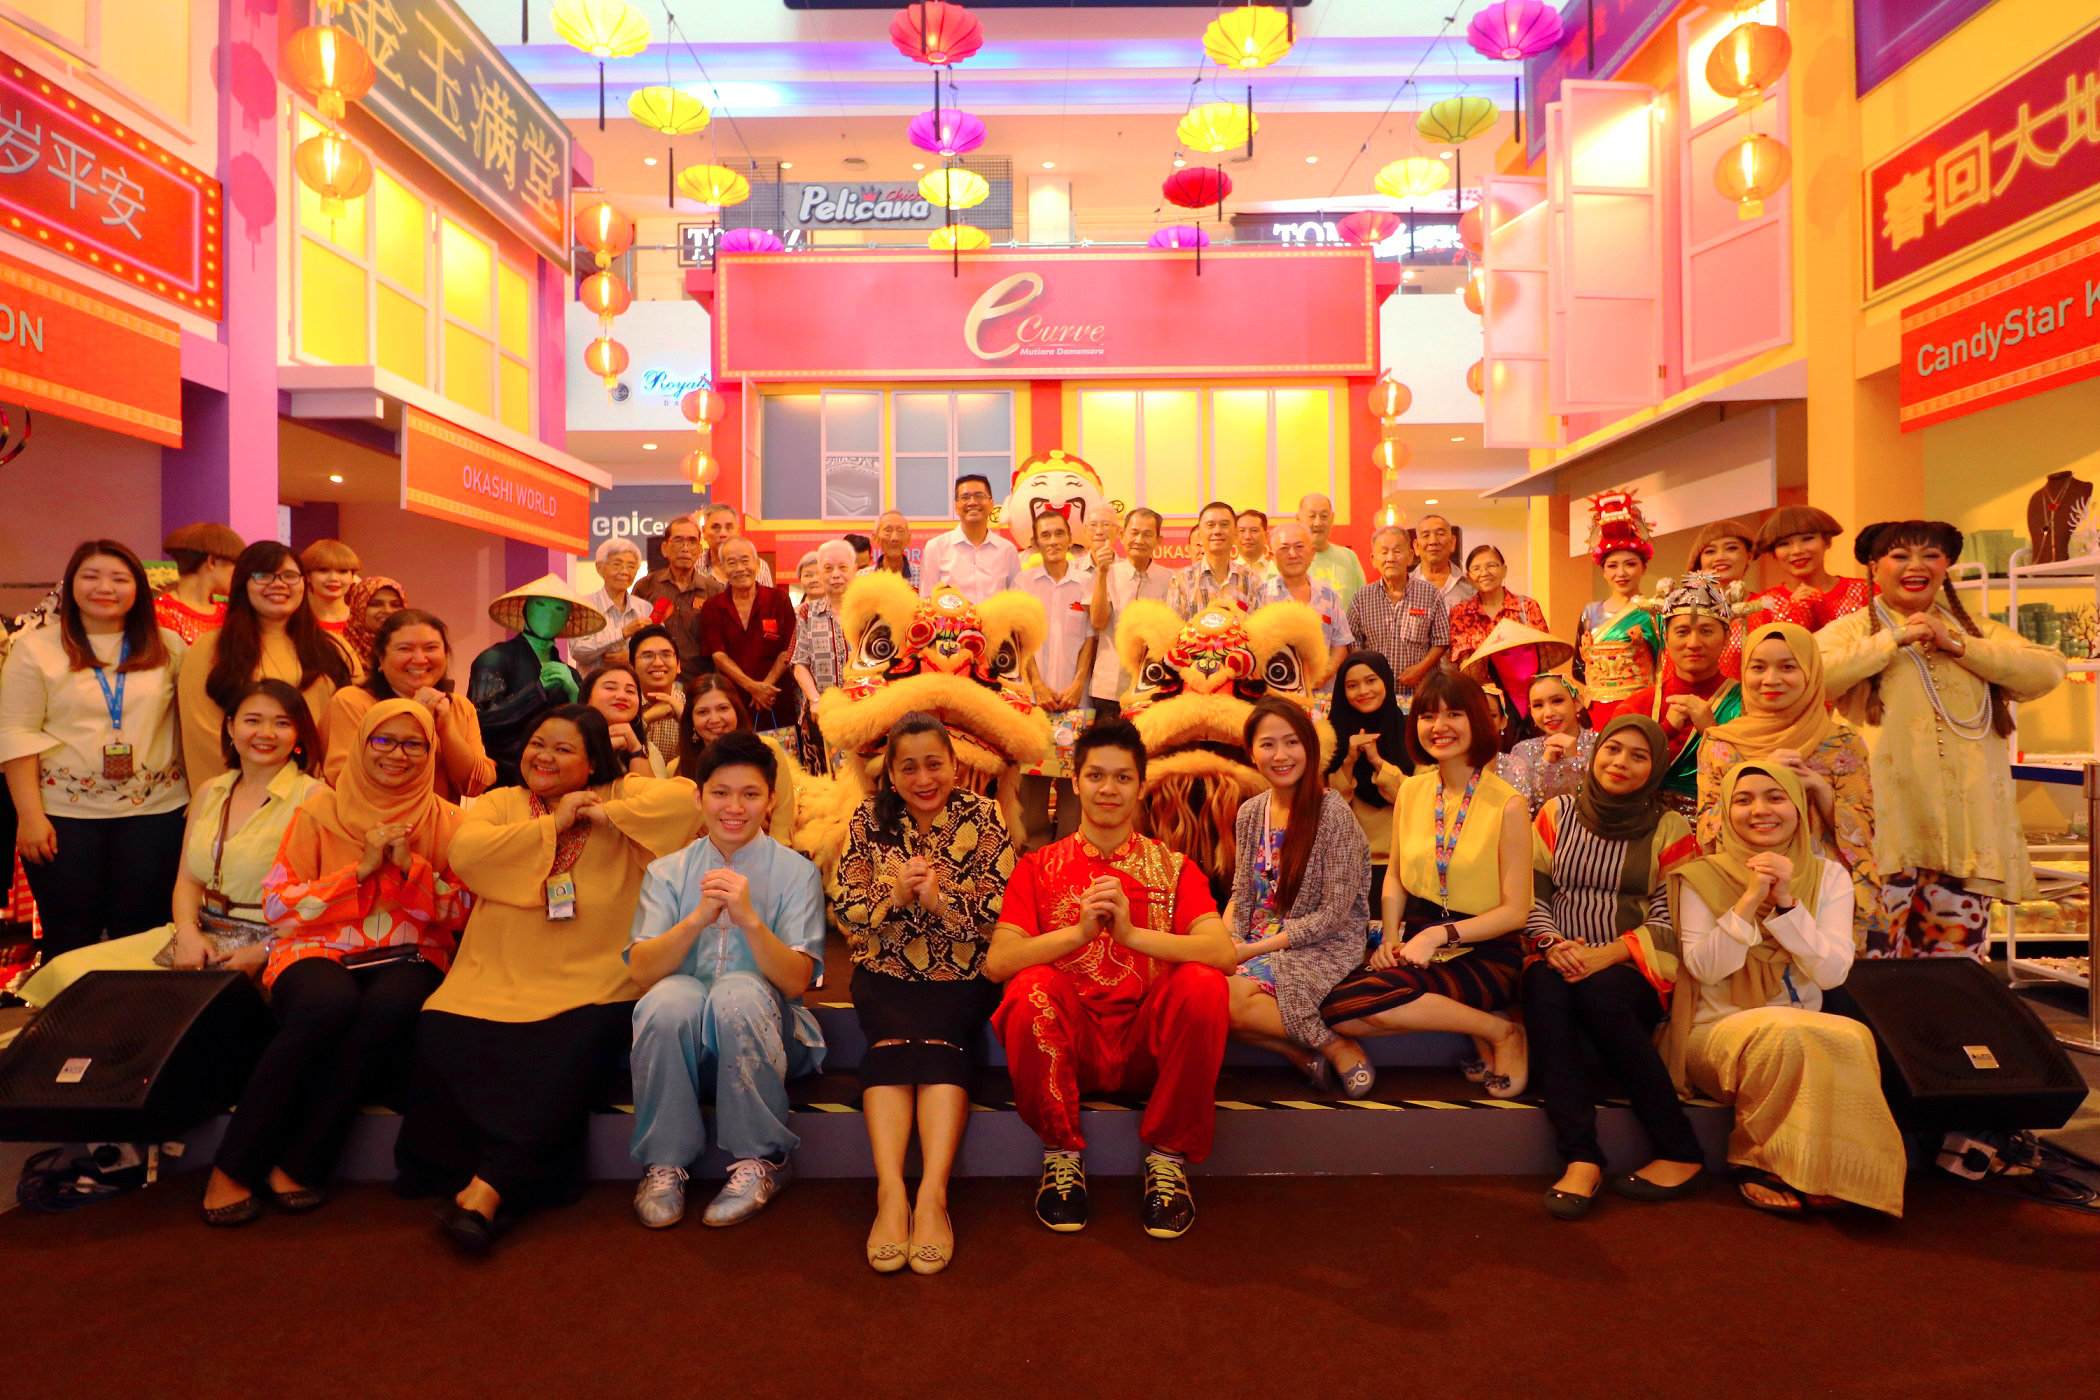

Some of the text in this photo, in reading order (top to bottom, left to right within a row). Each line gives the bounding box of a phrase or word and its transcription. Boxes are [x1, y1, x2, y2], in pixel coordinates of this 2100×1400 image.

[799, 185, 931, 224] Pelicana
[1017, 315, 1105, 342] Curve
[1917, 297, 2074, 376] CandyStar
[1020, 348, 1105, 356] Mutiara Damansara
[463, 465, 557, 517] OKASHI WORLD
